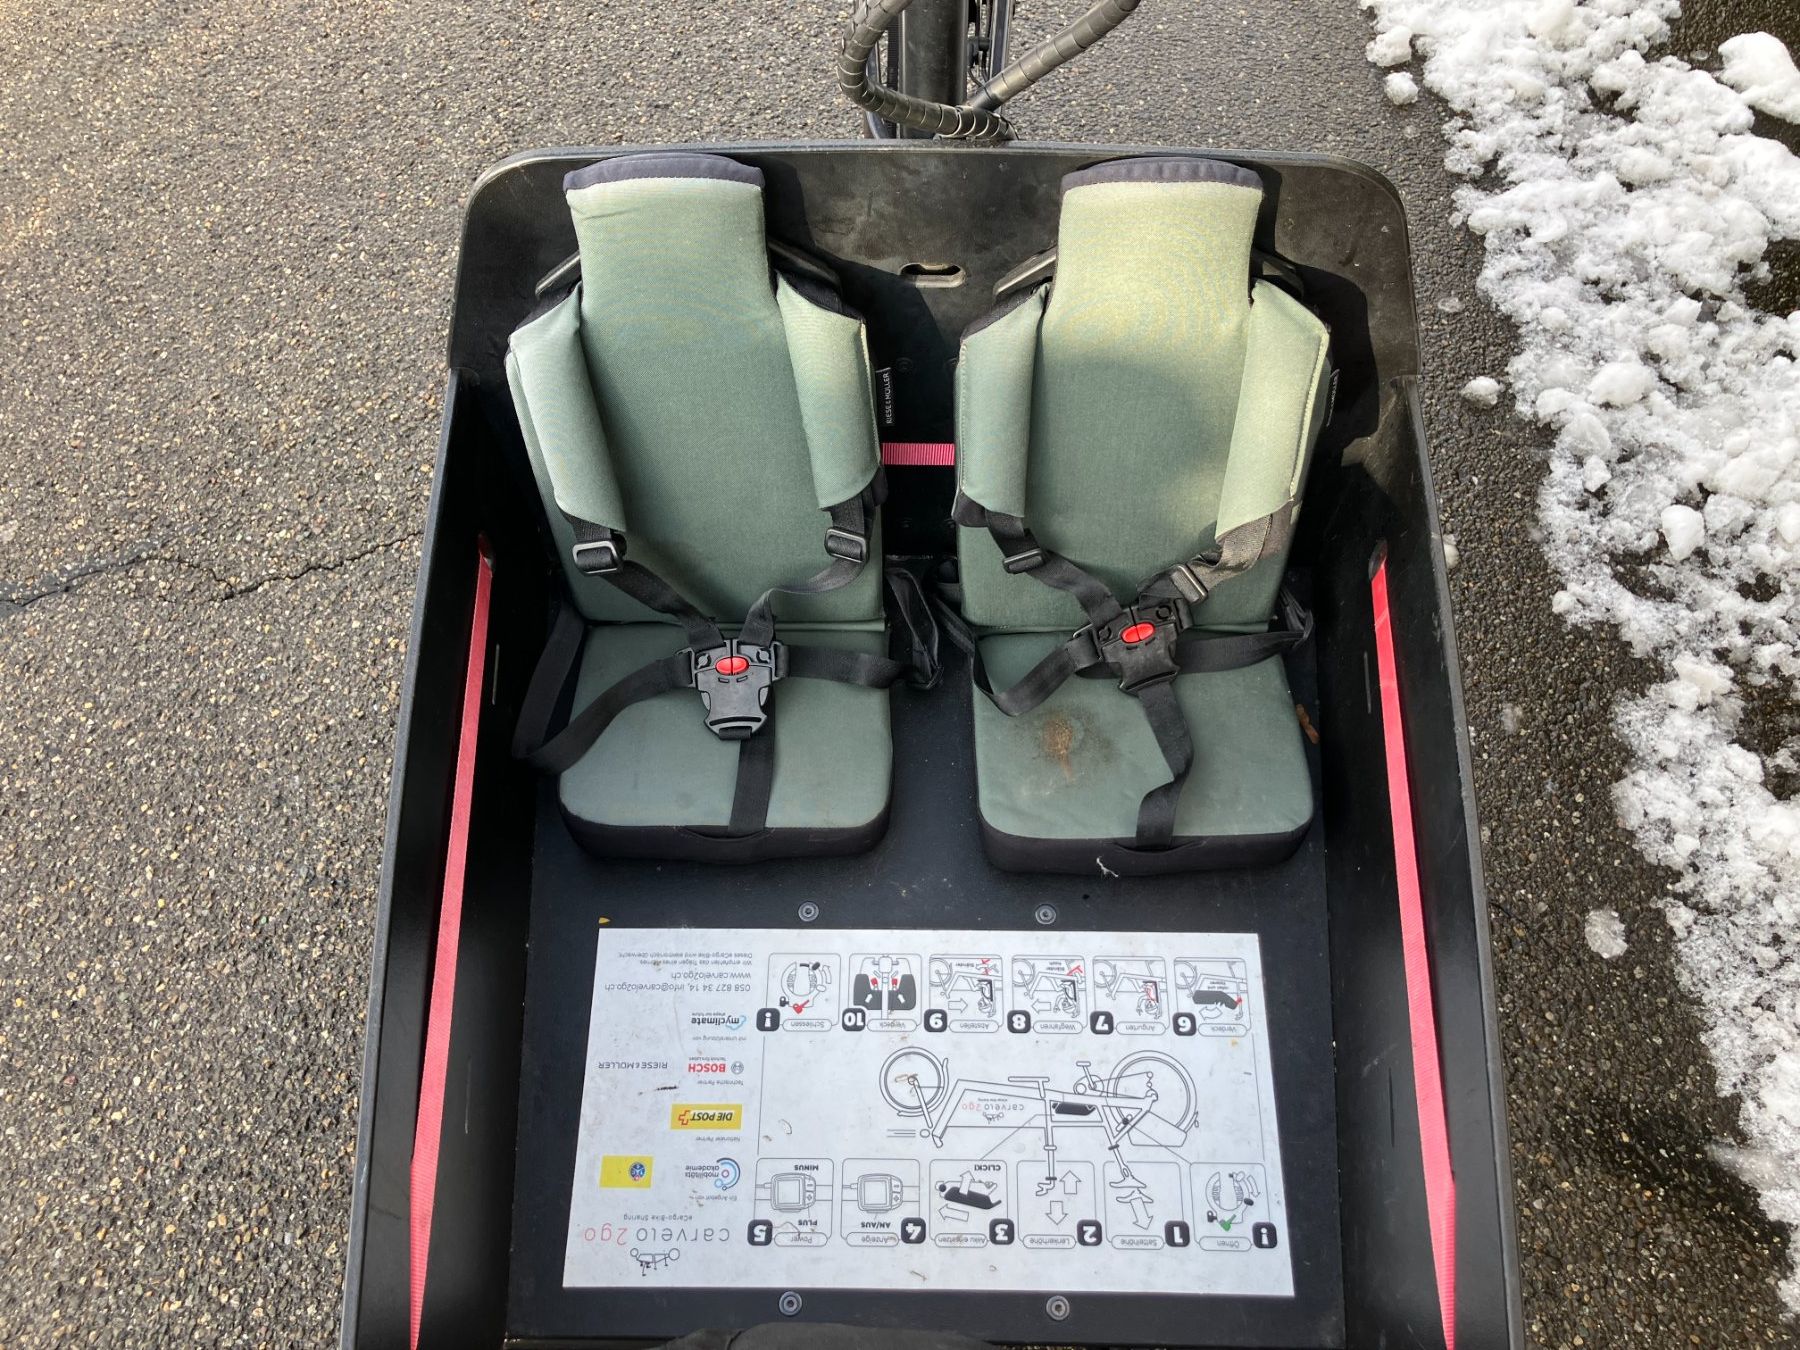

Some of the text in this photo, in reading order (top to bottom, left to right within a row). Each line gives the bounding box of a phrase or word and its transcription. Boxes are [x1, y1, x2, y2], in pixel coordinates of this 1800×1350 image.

[672, 972, 751, 980] www.carvelo2go.ch
[605, 982, 684, 992] info@carvelo2go.ch
[691, 1015, 739, 1026] myclimate
[844, 1012, 864, 1026] 10
[930, 1013, 942, 1028] 9
[1012, 1014, 1026, 1029] 8
[1096, 1016, 1108, 1030] 7
[1178, 1017, 1191, 1032] 6
[688, 1063, 726, 1072] BOSCH
[690, 1112, 733, 1121] DIE POST
[584, 1223, 729, 1245] carvelo 2go
[754, 1225, 767, 1242] 5
[906, 1223, 921, 1240] 4
[996, 1224, 1008, 1241] 3
[1083, 1226, 1096, 1242] 2
[1174, 1226, 1183, 1243] 1
[861, 1235, 888, 1243] Anzeige
[1121, 1239, 1157, 1247] Sattelhöhe
[1217, 1240, 1239, 1248] Öffnen
